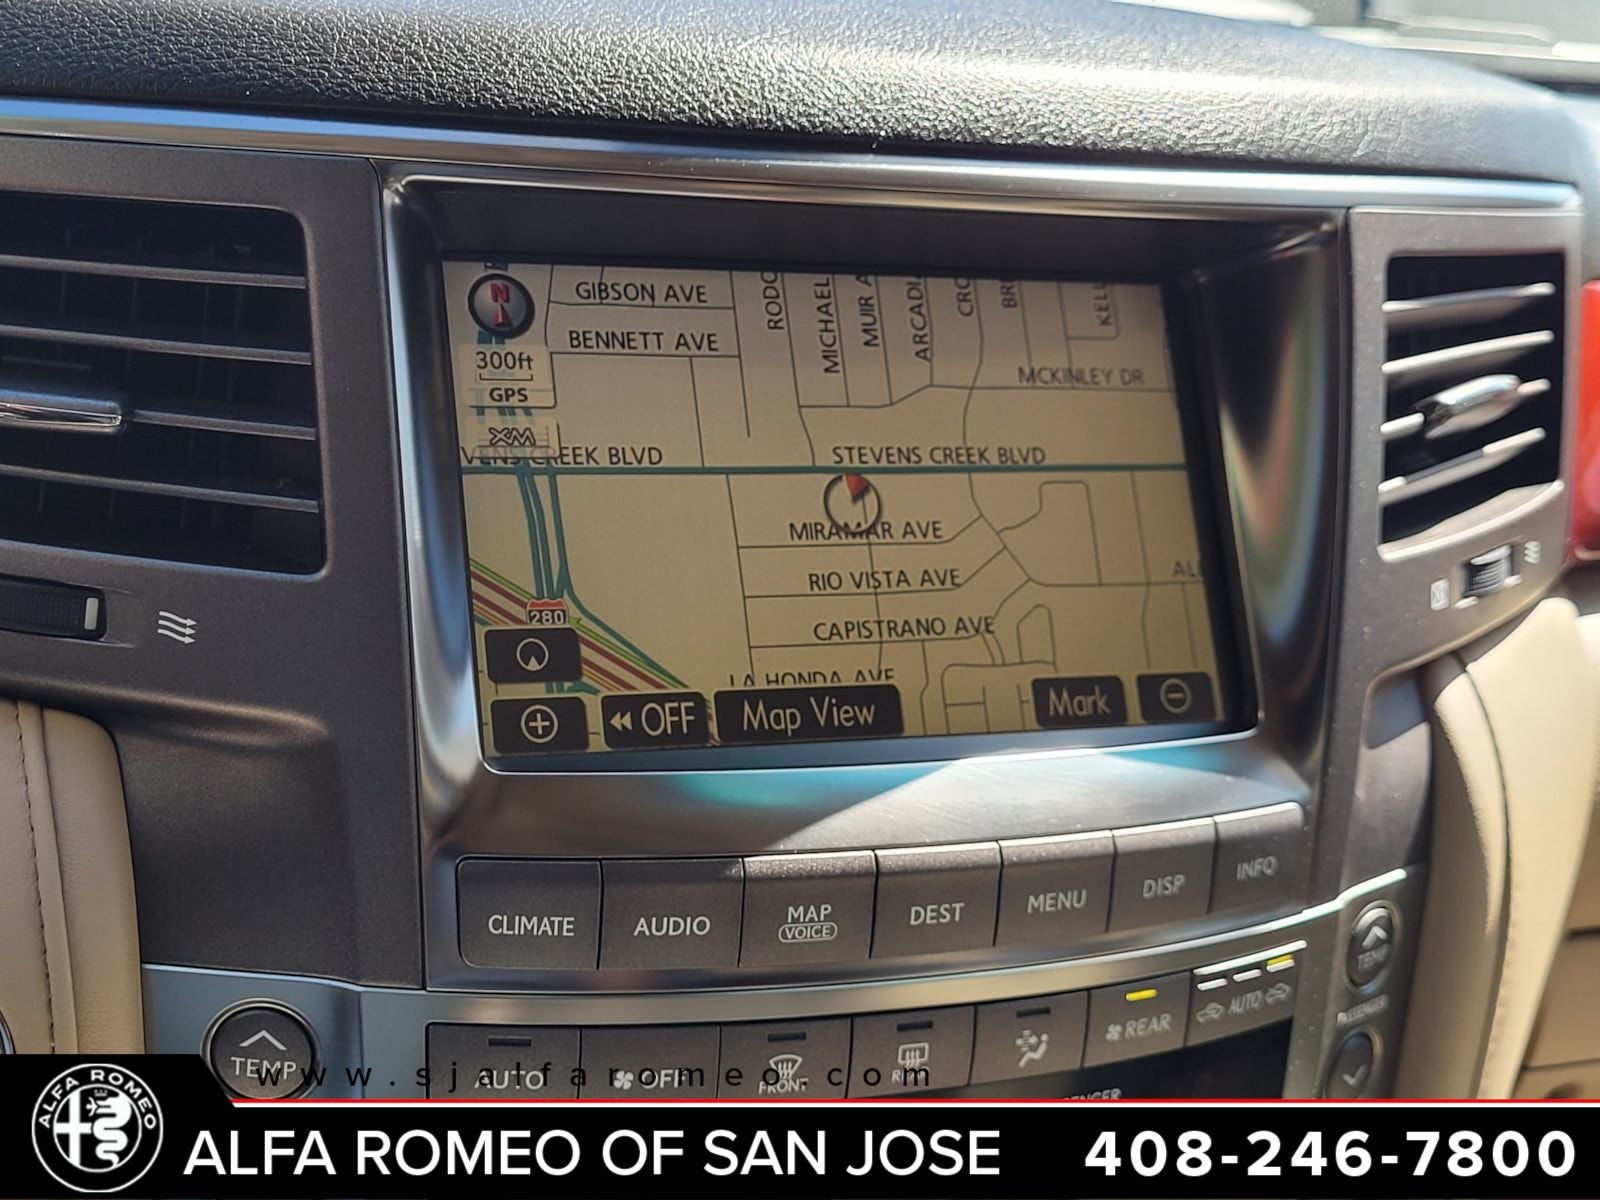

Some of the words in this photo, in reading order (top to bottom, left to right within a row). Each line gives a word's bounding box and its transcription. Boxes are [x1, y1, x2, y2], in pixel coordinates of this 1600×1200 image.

[490, 282, 511, 303] N
[575, 281, 655, 301] GIBSON
[664, 284, 708, 303] AVE
[814, 277, 840, 374] MICHAEL
[858, 296, 880, 347] MUIR
[905, 277, 931, 364] ARCADI
[568, 331, 663, 350] BENNETT
[675, 333, 719, 351] AVE
[476, 351, 534, 371] 300ft
[1018, 366, 1112, 385] MCKINLEY
[1120, 369, 1145, 386] DR
[489, 387, 528, 403] GPS
[489, 427, 536, 446] XM
[608, 447, 663, 465] BLVD
[833, 447, 922, 465] STEVENS
[929, 447, 993, 465] CREEK
[999, 447, 1047, 465] BLVD
[789, 521, 893, 541] MIRAMAR
[902, 521, 943, 539] AVE
[808, 572, 843, 591] RIO
[850, 570, 910, 589] VISTA
[920, 568, 961, 587] AVE
[529, 610, 564, 625] 280
[813, 617, 946, 641] CAPISTRANO
[954, 616, 995, 634] AVE
[1049, 685, 1111, 717] Mark
[641, 702, 695, 736] OFF
[743, 700, 802, 737] Map
[809, 696, 876, 728] View
[1236, 855, 1279, 881] INFO
[1142, 874, 1186, 899] DISP
[1027, 889, 1088, 914] MENU
[787, 904, 832, 923] MAP
[909, 902, 965, 926] DEST
[488, 914, 575, 937] CLIMATE
[633, 916, 711, 937] AUDIO
[784, 924, 832, 940] VOICE
[1228, 990, 1264, 1014] AUTO
[1125, 1014, 1172, 1039] REAR
[230, 1056, 297, 1080] TEMP
